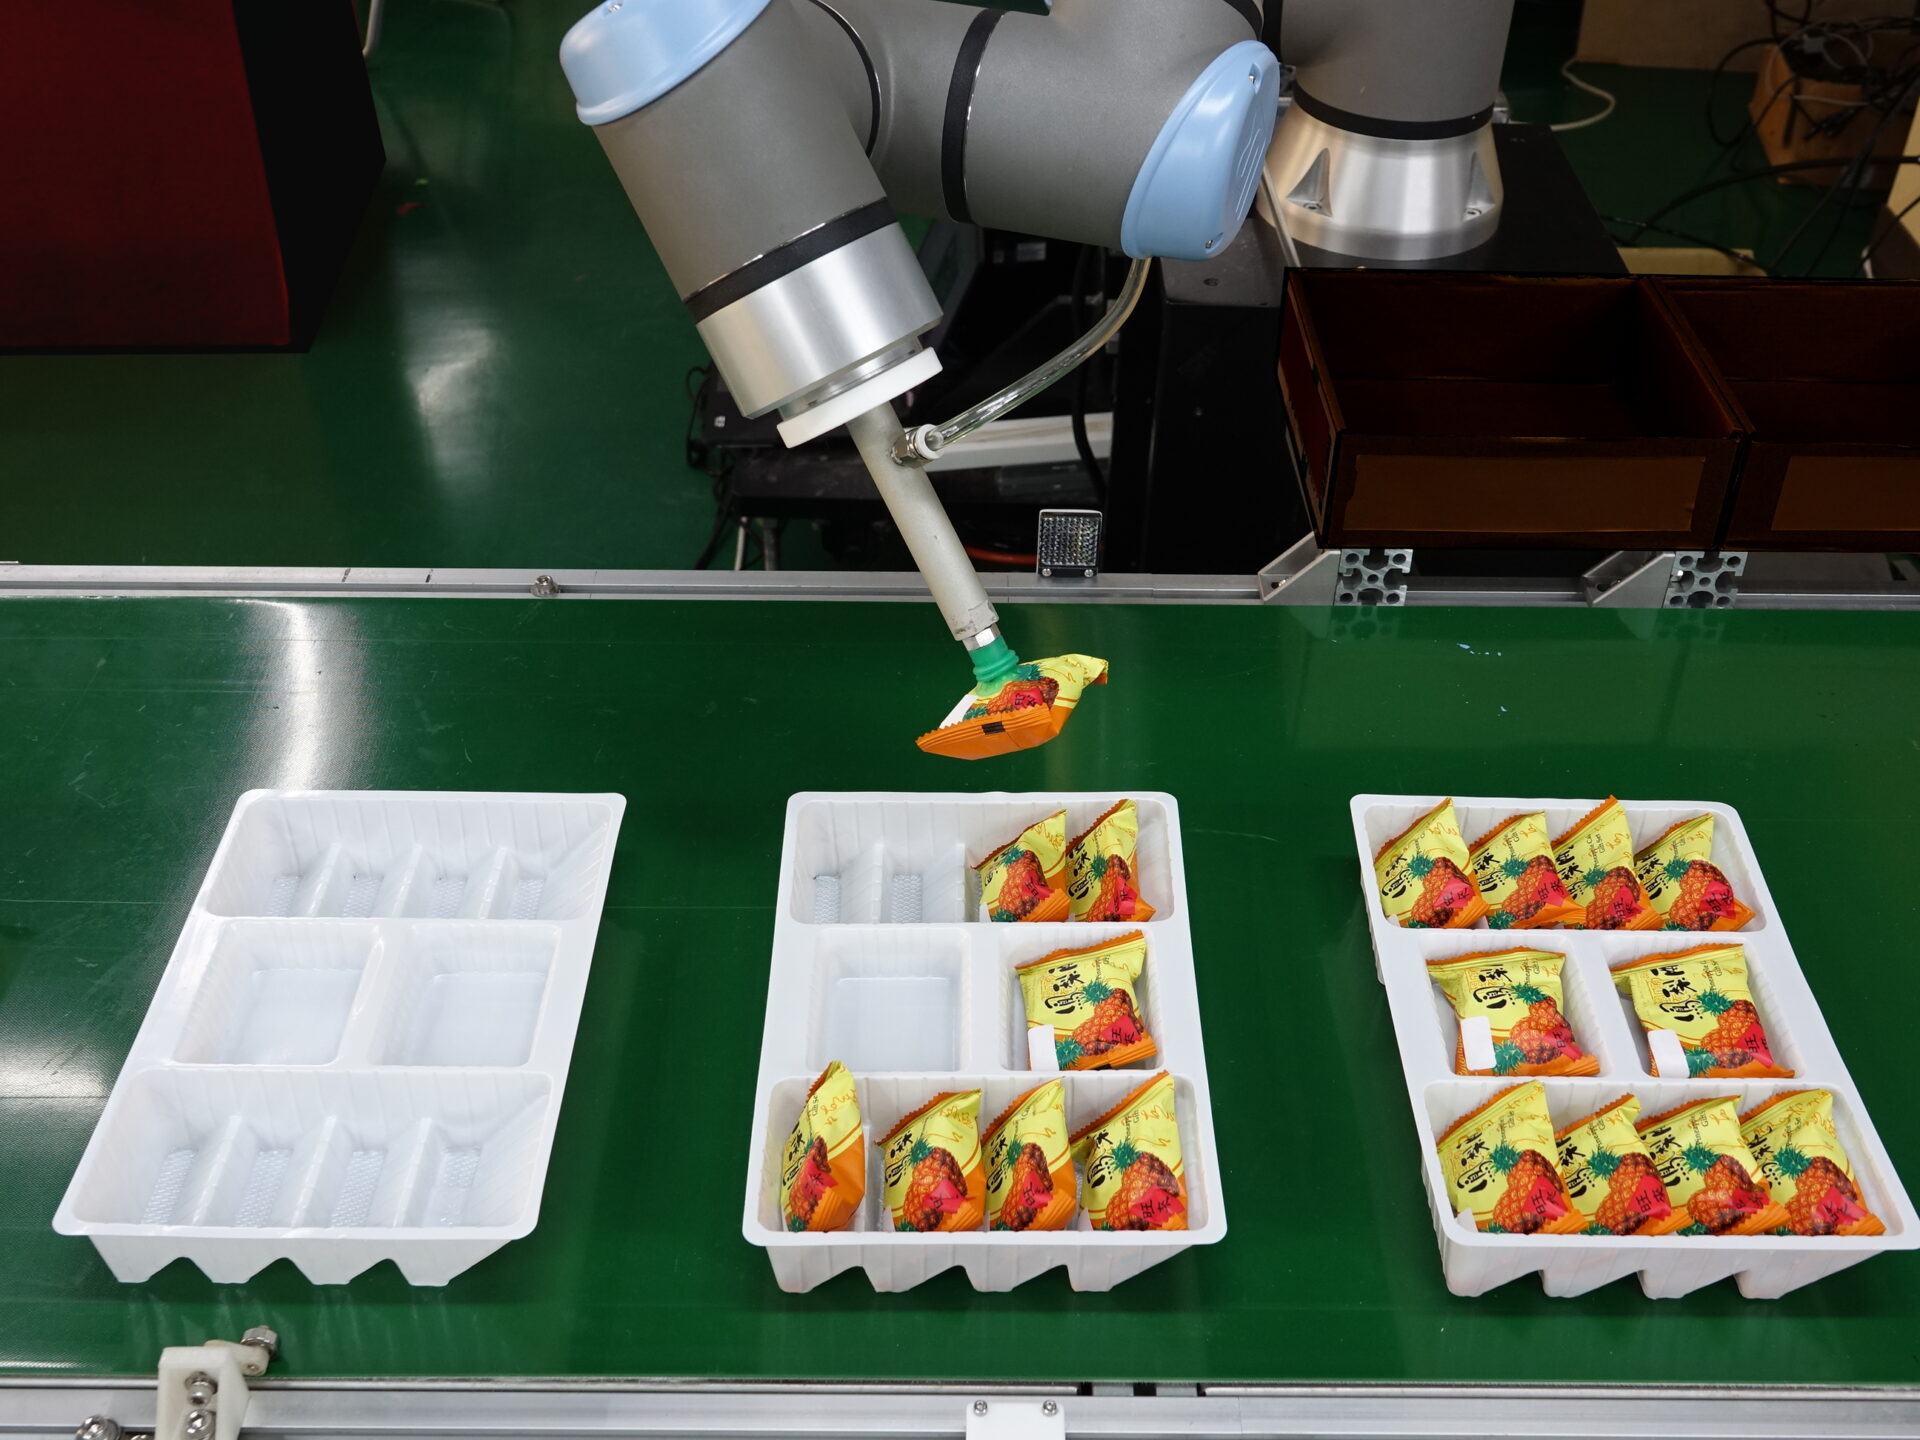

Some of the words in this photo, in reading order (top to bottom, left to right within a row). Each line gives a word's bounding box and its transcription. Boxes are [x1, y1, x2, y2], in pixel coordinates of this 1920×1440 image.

[1474, 848, 1501, 893] 鳳梨
[1638, 853, 1668, 900] 鳳梨
[1556, 1137, 1596, 1198] 鳳梨
